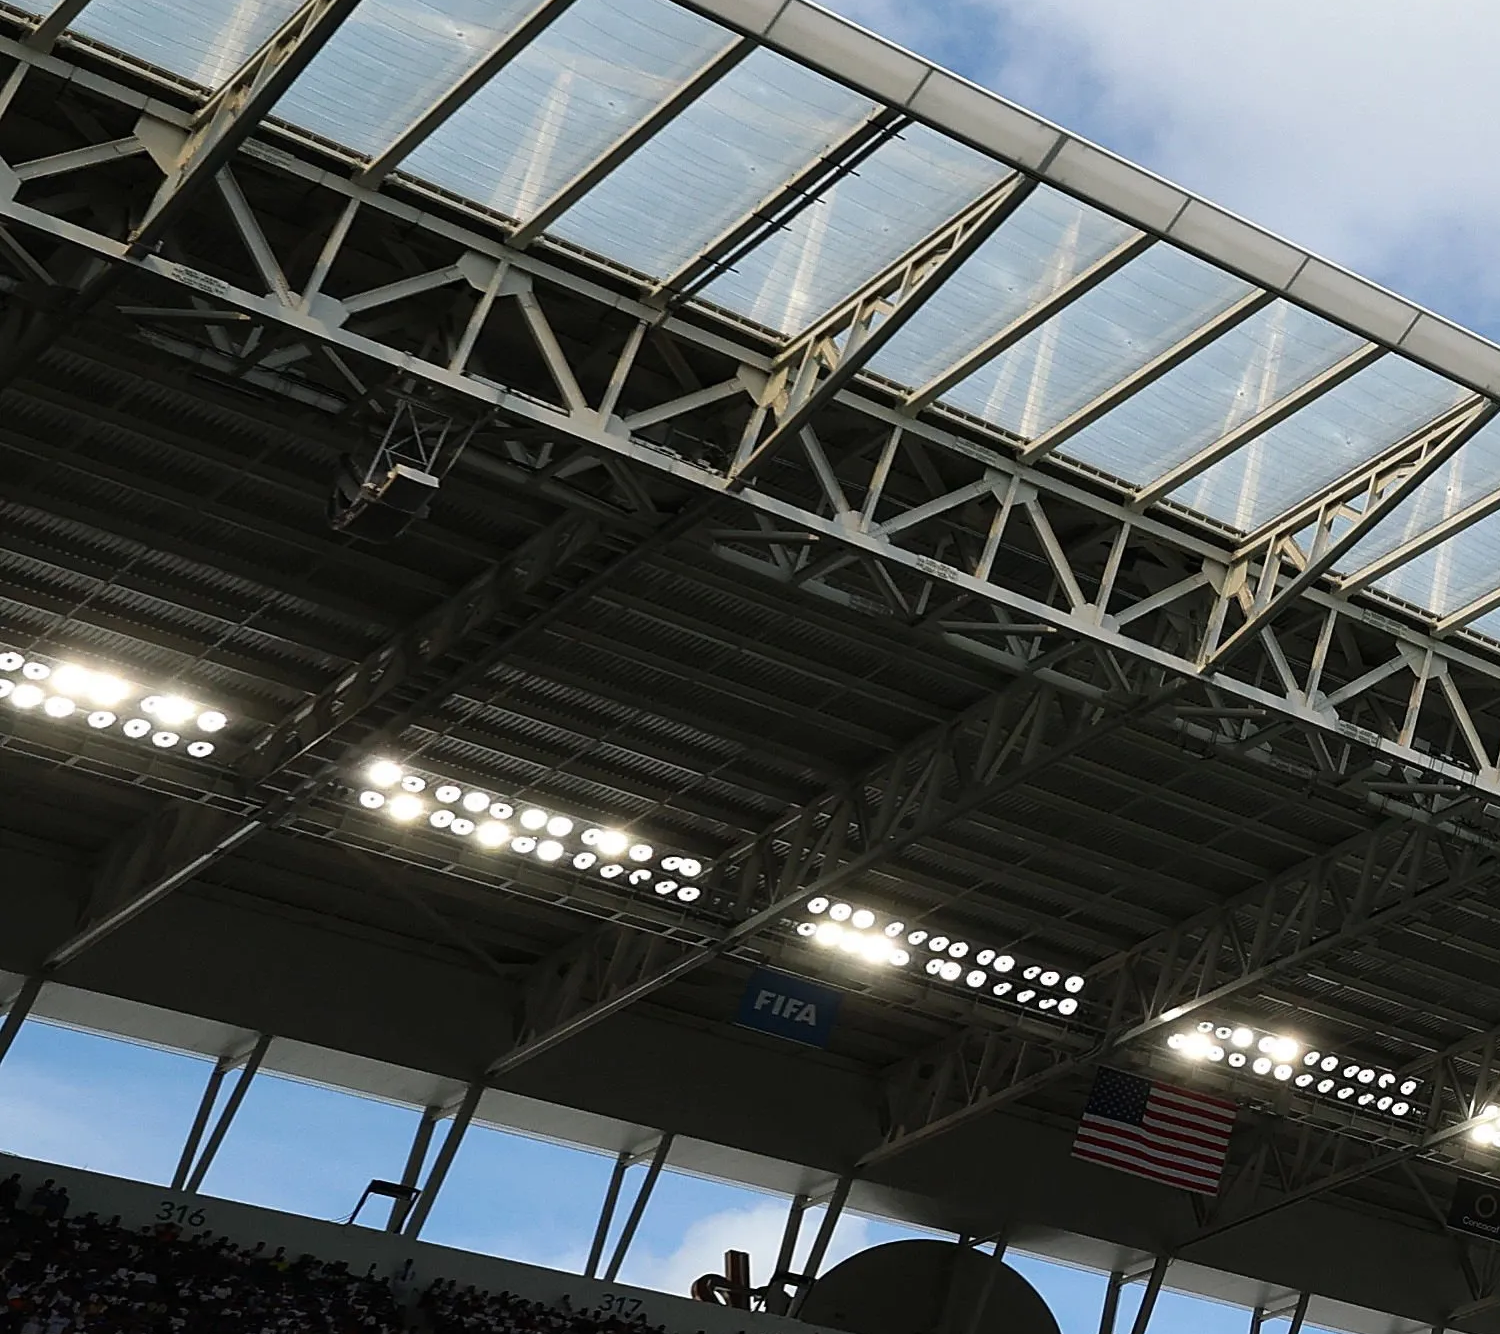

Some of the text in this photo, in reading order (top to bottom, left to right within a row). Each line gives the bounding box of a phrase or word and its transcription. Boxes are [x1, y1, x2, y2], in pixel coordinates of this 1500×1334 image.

[754, 990, 818, 1027] FIFA
[156, 1201, 206, 1227] 316
[601, 1293, 643, 1317] 317
